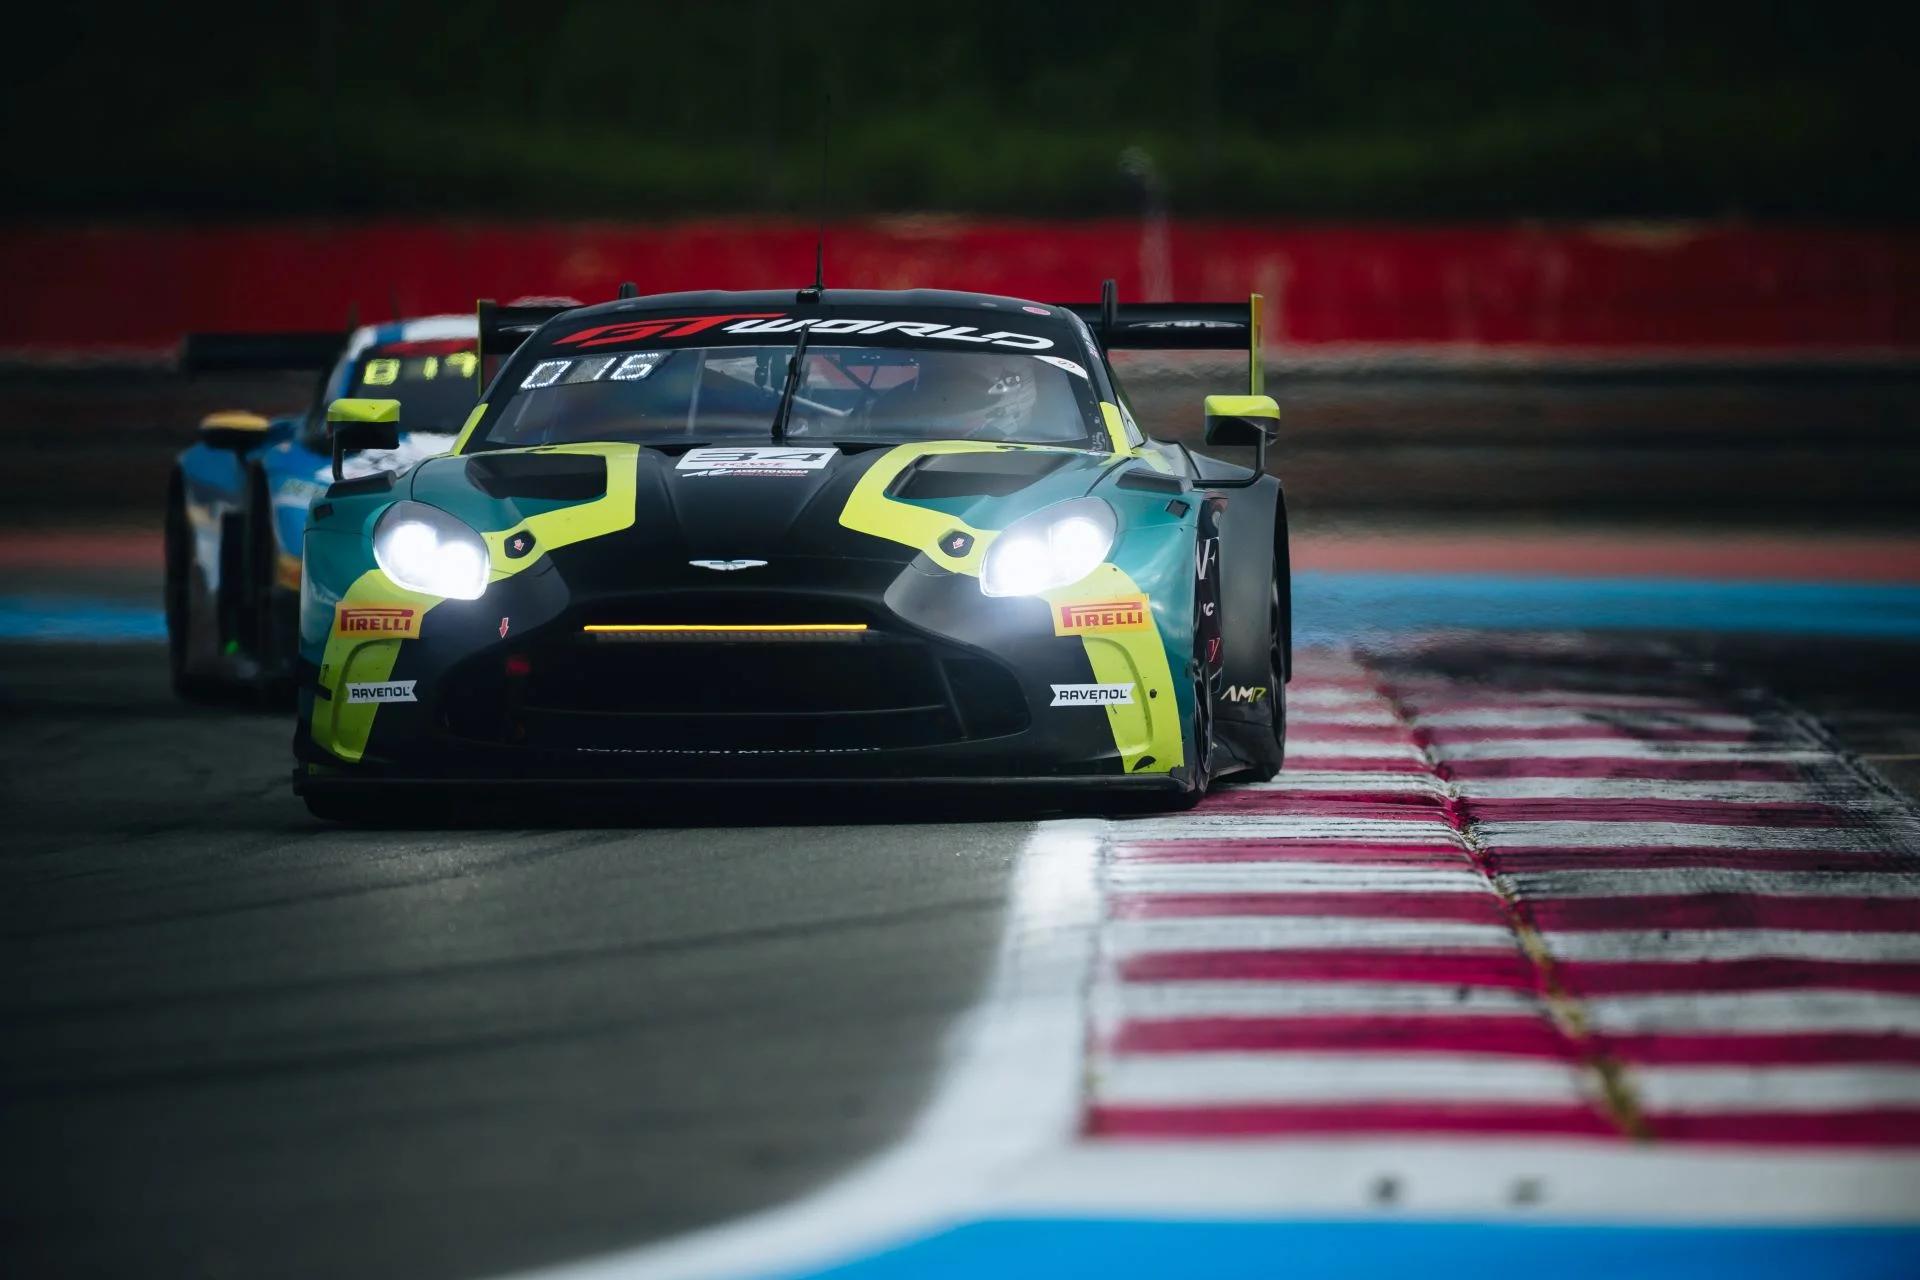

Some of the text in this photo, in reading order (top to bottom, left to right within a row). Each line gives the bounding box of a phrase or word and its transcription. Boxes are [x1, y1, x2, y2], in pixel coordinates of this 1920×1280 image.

[552, 313, 787, 348] GT
[722, 319, 1056, 350] WORLD
[520, 353, 658, 389] 016
[688, 453, 827, 462] 34
[341, 608, 414, 631] PIRELLI
[1061, 602, 1143, 627] PIRELLI
[352, 686, 410, 699] RAVENOL
[1059, 689, 1127, 701] RAVENOL
